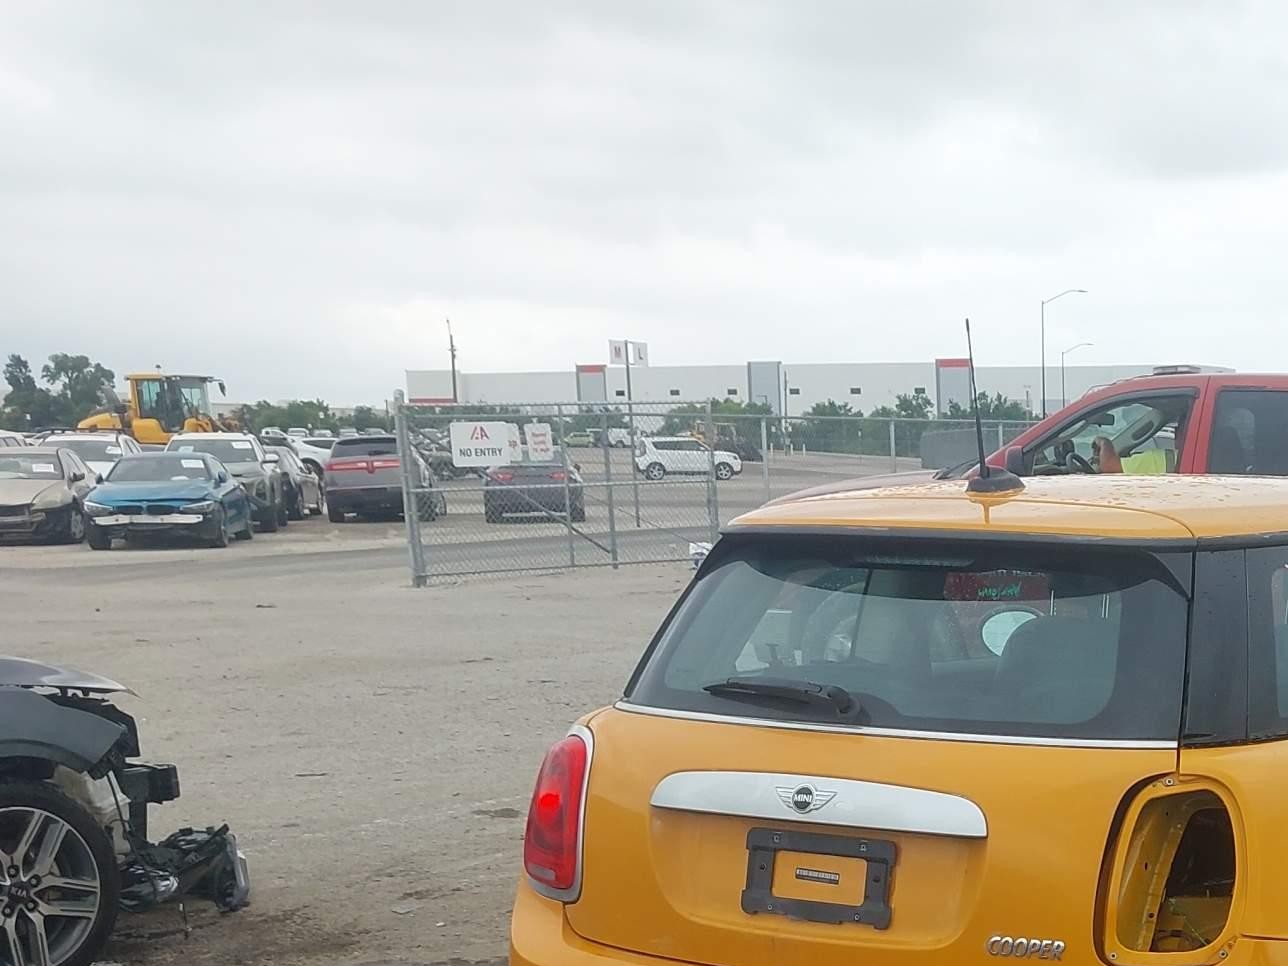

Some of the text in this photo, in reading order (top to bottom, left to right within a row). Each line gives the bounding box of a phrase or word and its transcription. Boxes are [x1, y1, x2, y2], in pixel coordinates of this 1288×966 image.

[459, 447, 503, 457] NO ENTRY
[793, 793, 812, 803] MINI
[10, 886, 27, 898] KIA
[986, 935, 1066, 961] COOPER
